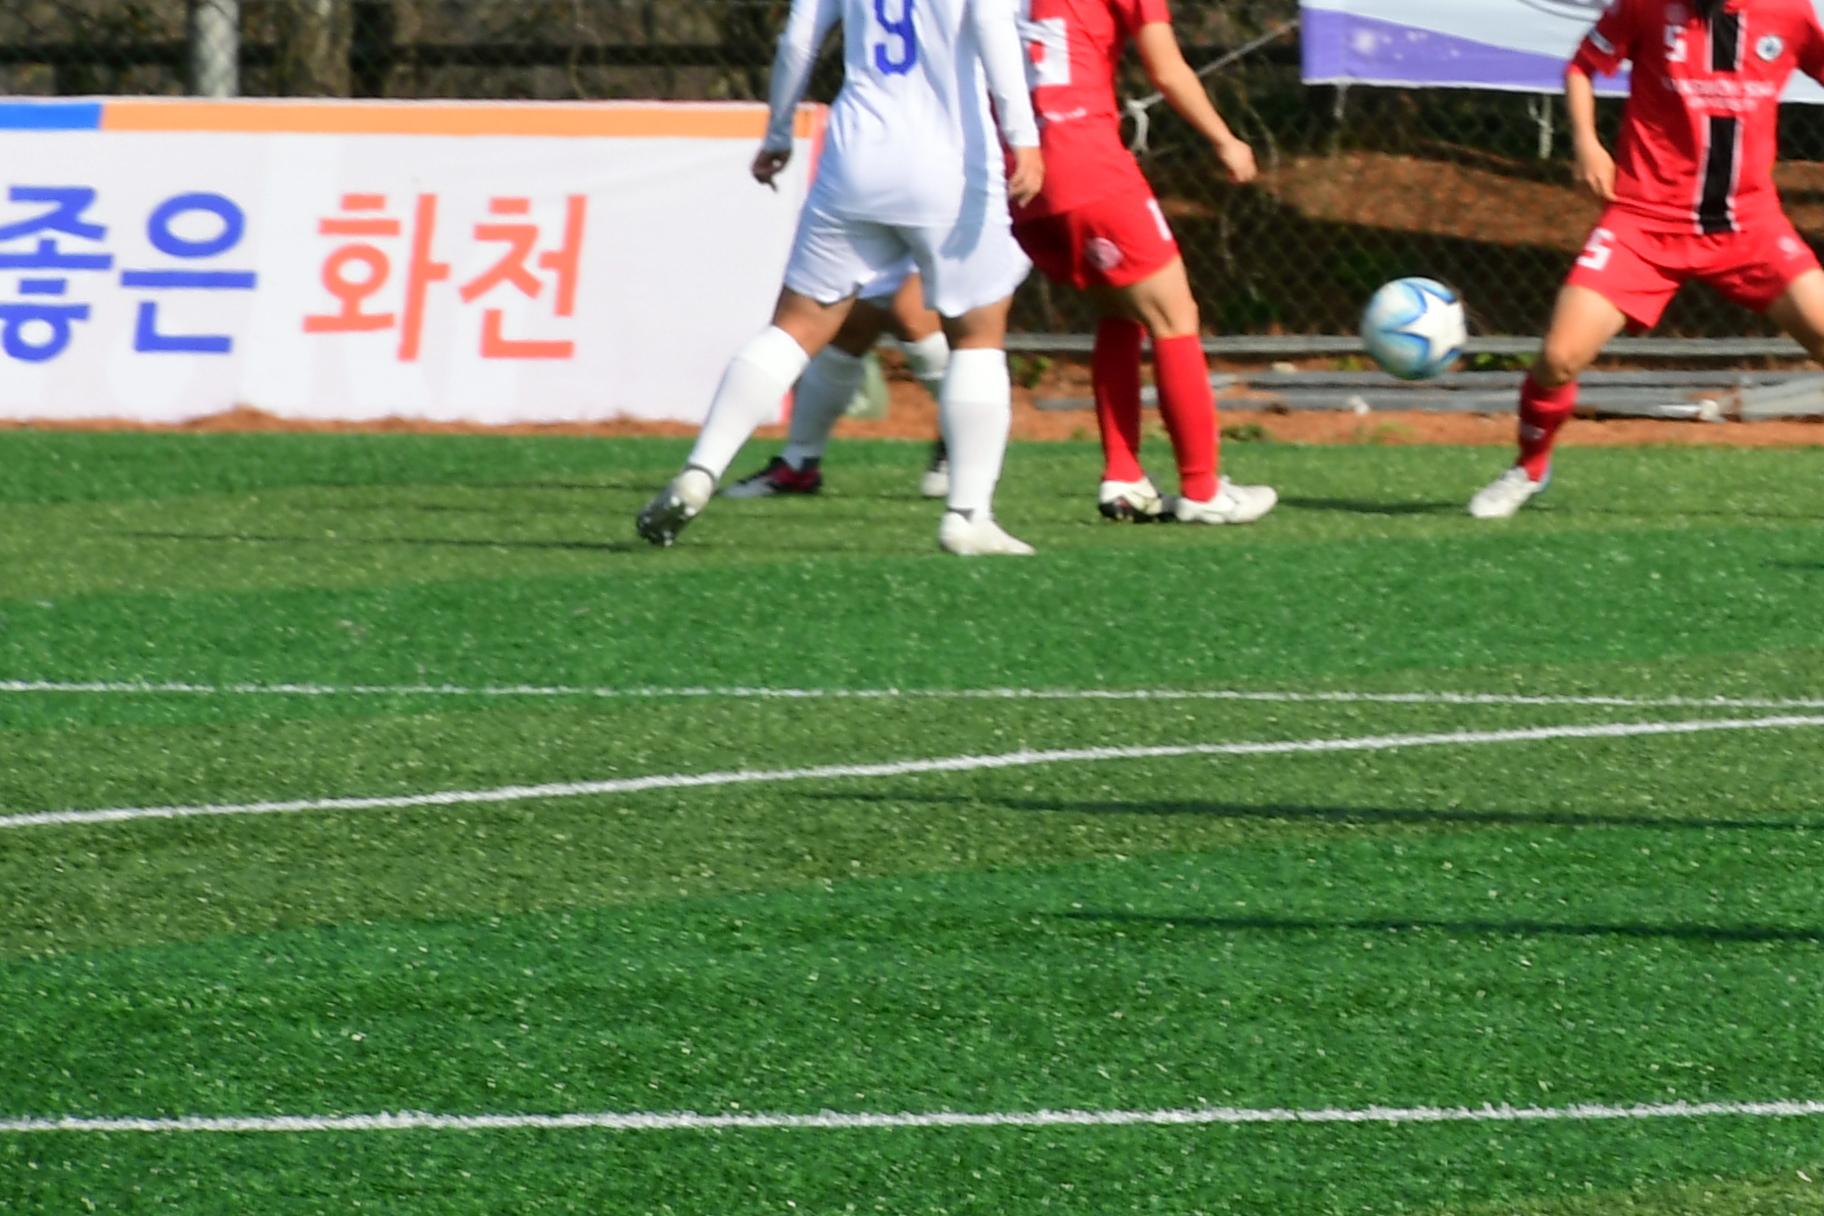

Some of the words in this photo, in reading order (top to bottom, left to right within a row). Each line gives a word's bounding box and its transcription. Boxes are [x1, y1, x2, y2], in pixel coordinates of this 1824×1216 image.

[1664, 24, 1689, 63] 5
[1576, 227, 1617, 270] 5
[0, 186, 257, 363] 좋은
[302, 193, 589, 363] 화천
